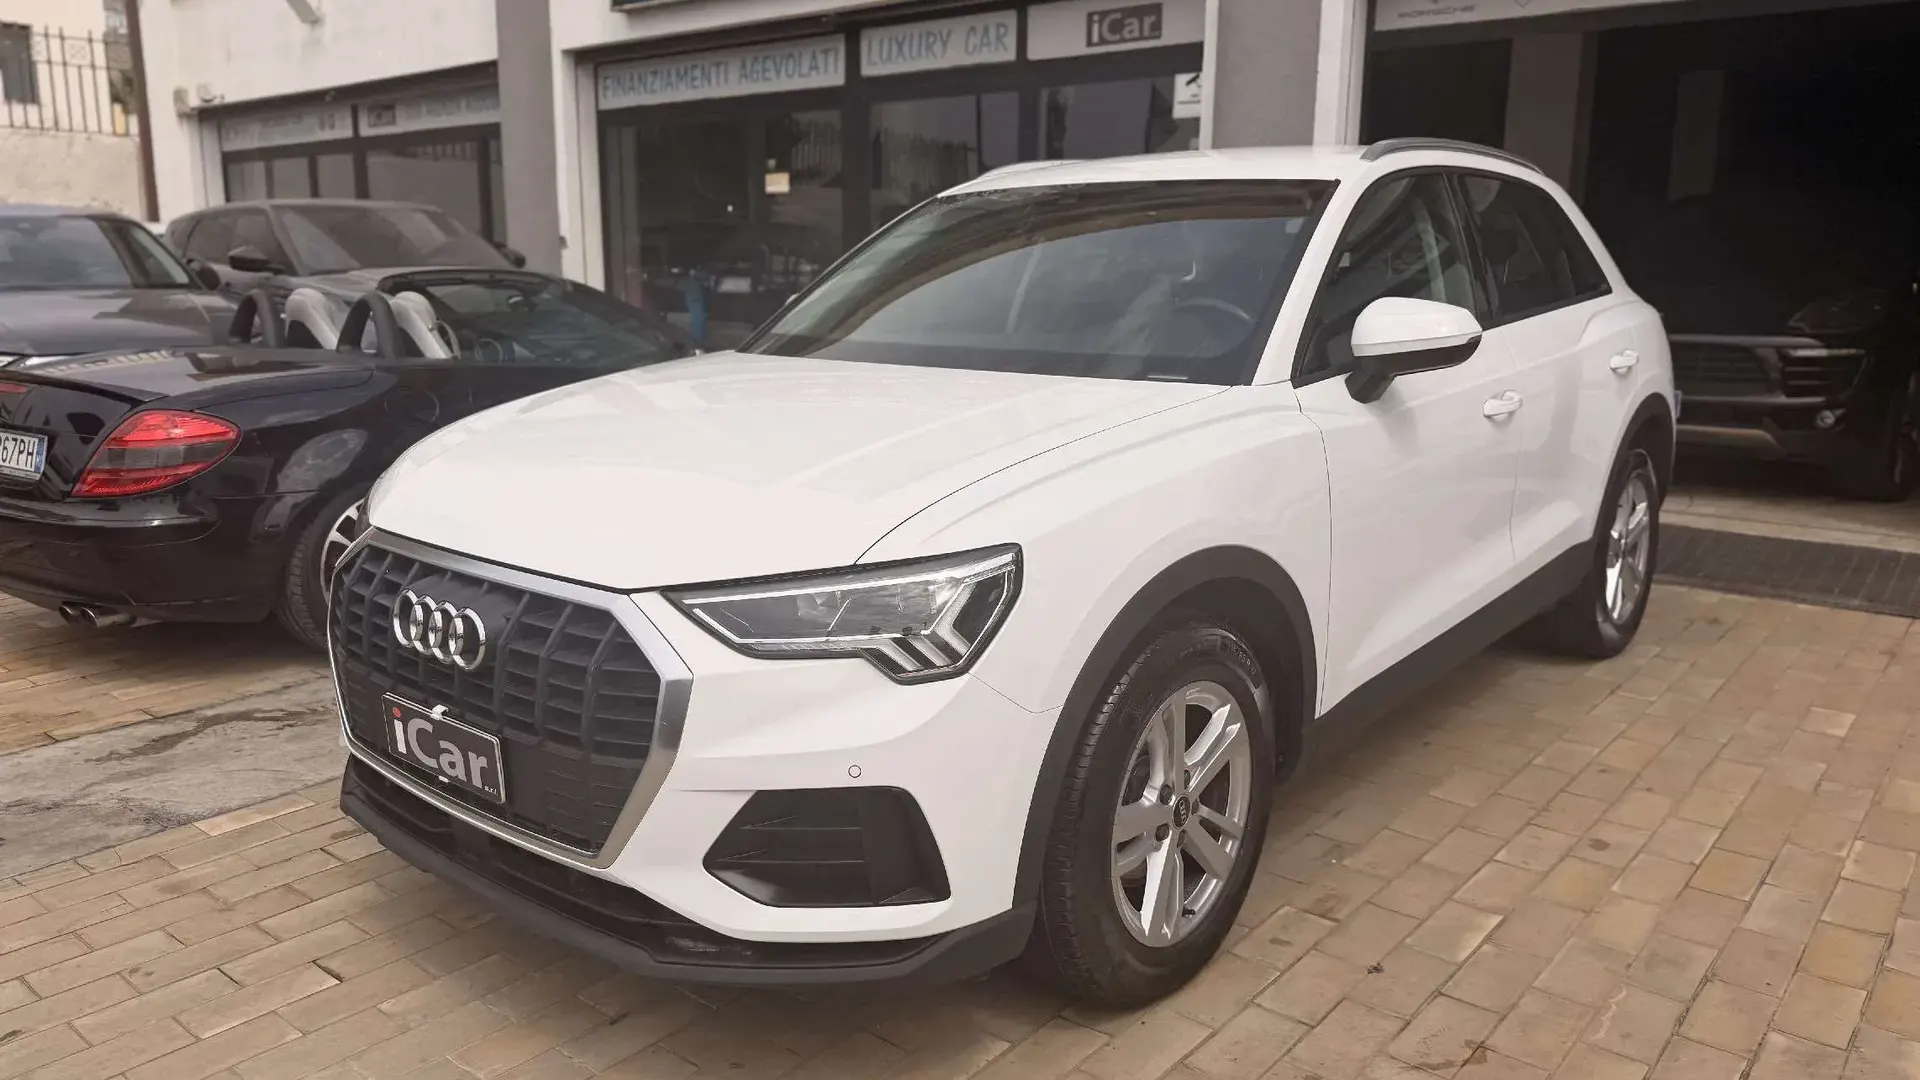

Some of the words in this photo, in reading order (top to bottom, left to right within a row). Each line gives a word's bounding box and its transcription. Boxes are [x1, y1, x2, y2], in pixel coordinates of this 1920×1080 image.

[866, 28, 952, 66] LUXURY
[964, 22, 1009, 56] CAR
[1091, 12, 1156, 43] iCar
[602, 60, 729, 99] FINANZIAMENTI
[738, 48, 839, 85] AGEVOLATI
[0, 435, 36, 468] 67PH
[393, 707, 488, 788] iCar
